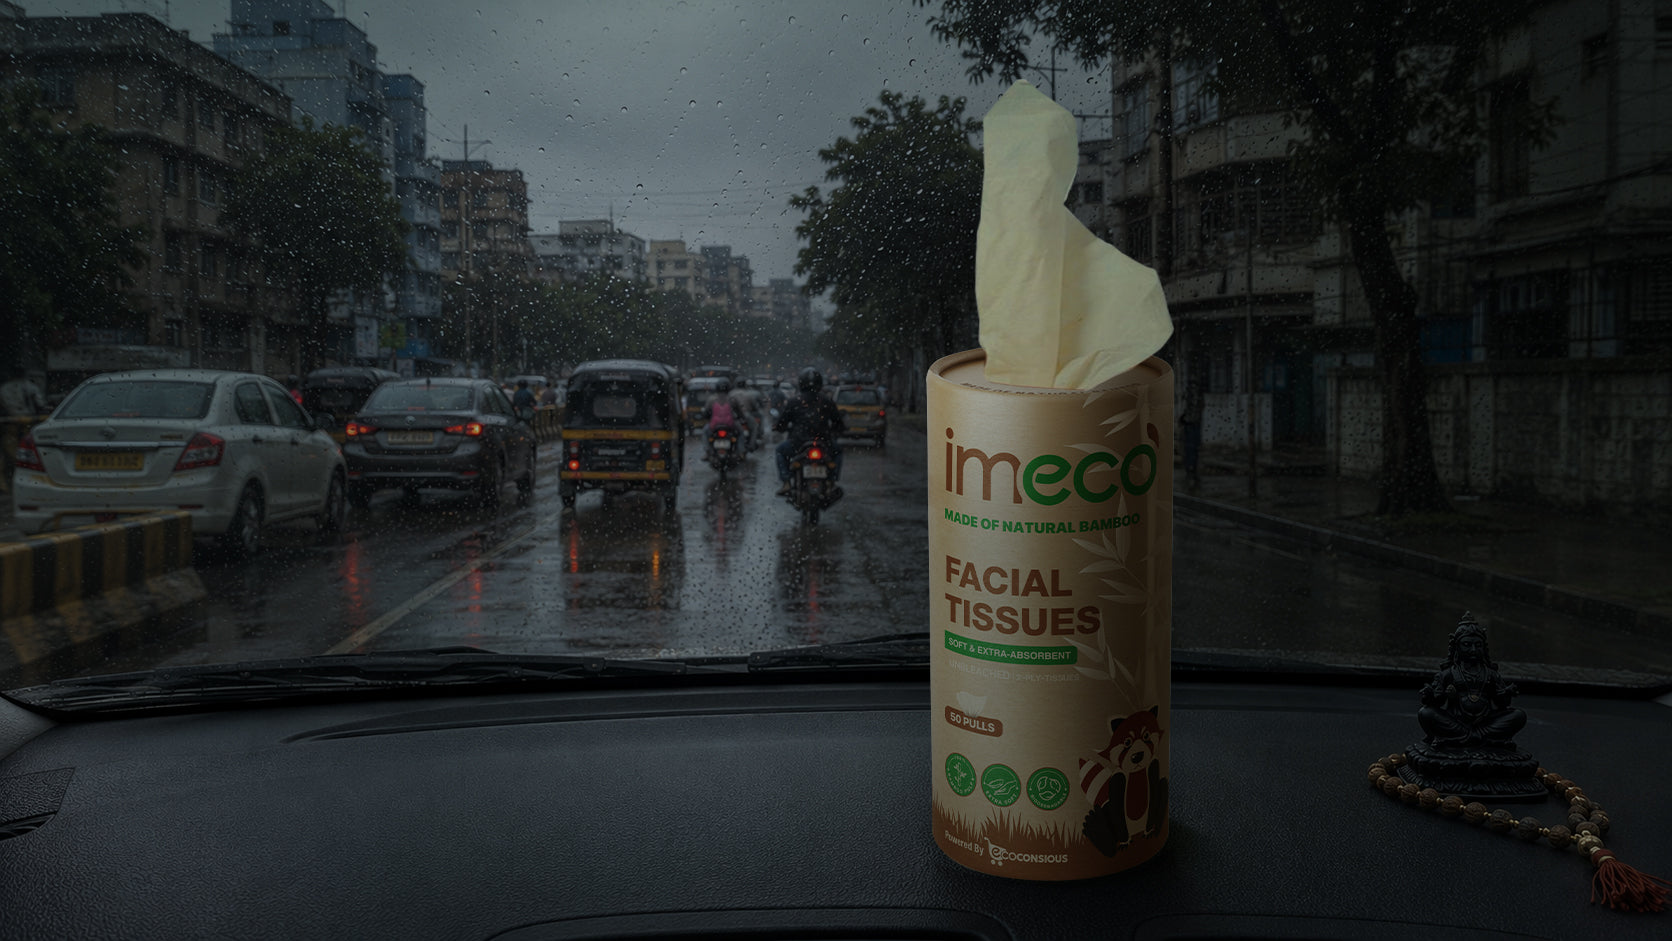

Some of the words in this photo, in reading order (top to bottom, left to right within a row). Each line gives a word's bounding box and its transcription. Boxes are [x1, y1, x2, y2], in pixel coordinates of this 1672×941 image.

[944, 508, 978, 528] MADE
[981, 518, 999, 531] OF
[1002, 520, 1076, 534] NATURAL
[1079, 513, 1141, 532] BAMBOO
[945, 555, 1073, 597] FACIAL
[945, 593, 1101, 636] TISSUES
[948, 637, 968, 652] SOFT
[969, 644, 976, 653] &
[977, 646, 1071, 660] EXTRA-ABSORBENT
[950, 711, 962, 724] 50
[963, 716, 995, 733] PULLS
[944, 830, 973, 851] Powered
[974, 843, 985, 857] By
